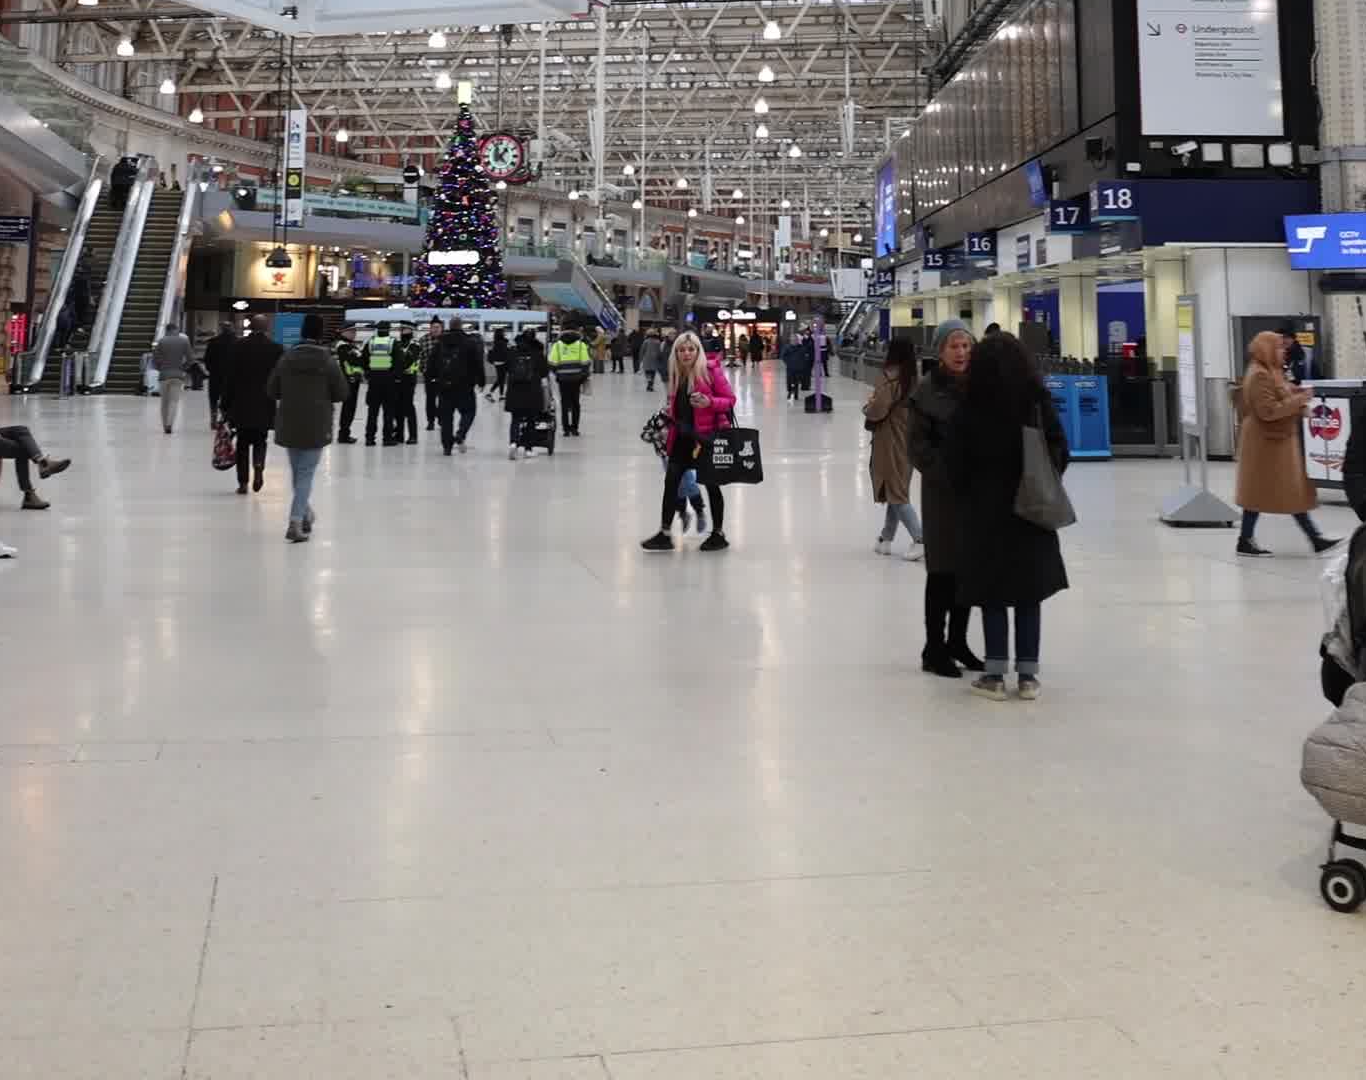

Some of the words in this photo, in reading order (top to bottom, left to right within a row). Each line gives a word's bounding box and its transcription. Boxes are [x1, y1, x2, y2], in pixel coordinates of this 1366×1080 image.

[1192, 24, 1255, 36] Underground
[1102, 188, 1133, 210] 18
[1054, 206, 1081, 226] 17
[971, 236, 991, 252] 16
[925, 253, 943, 267] 15
